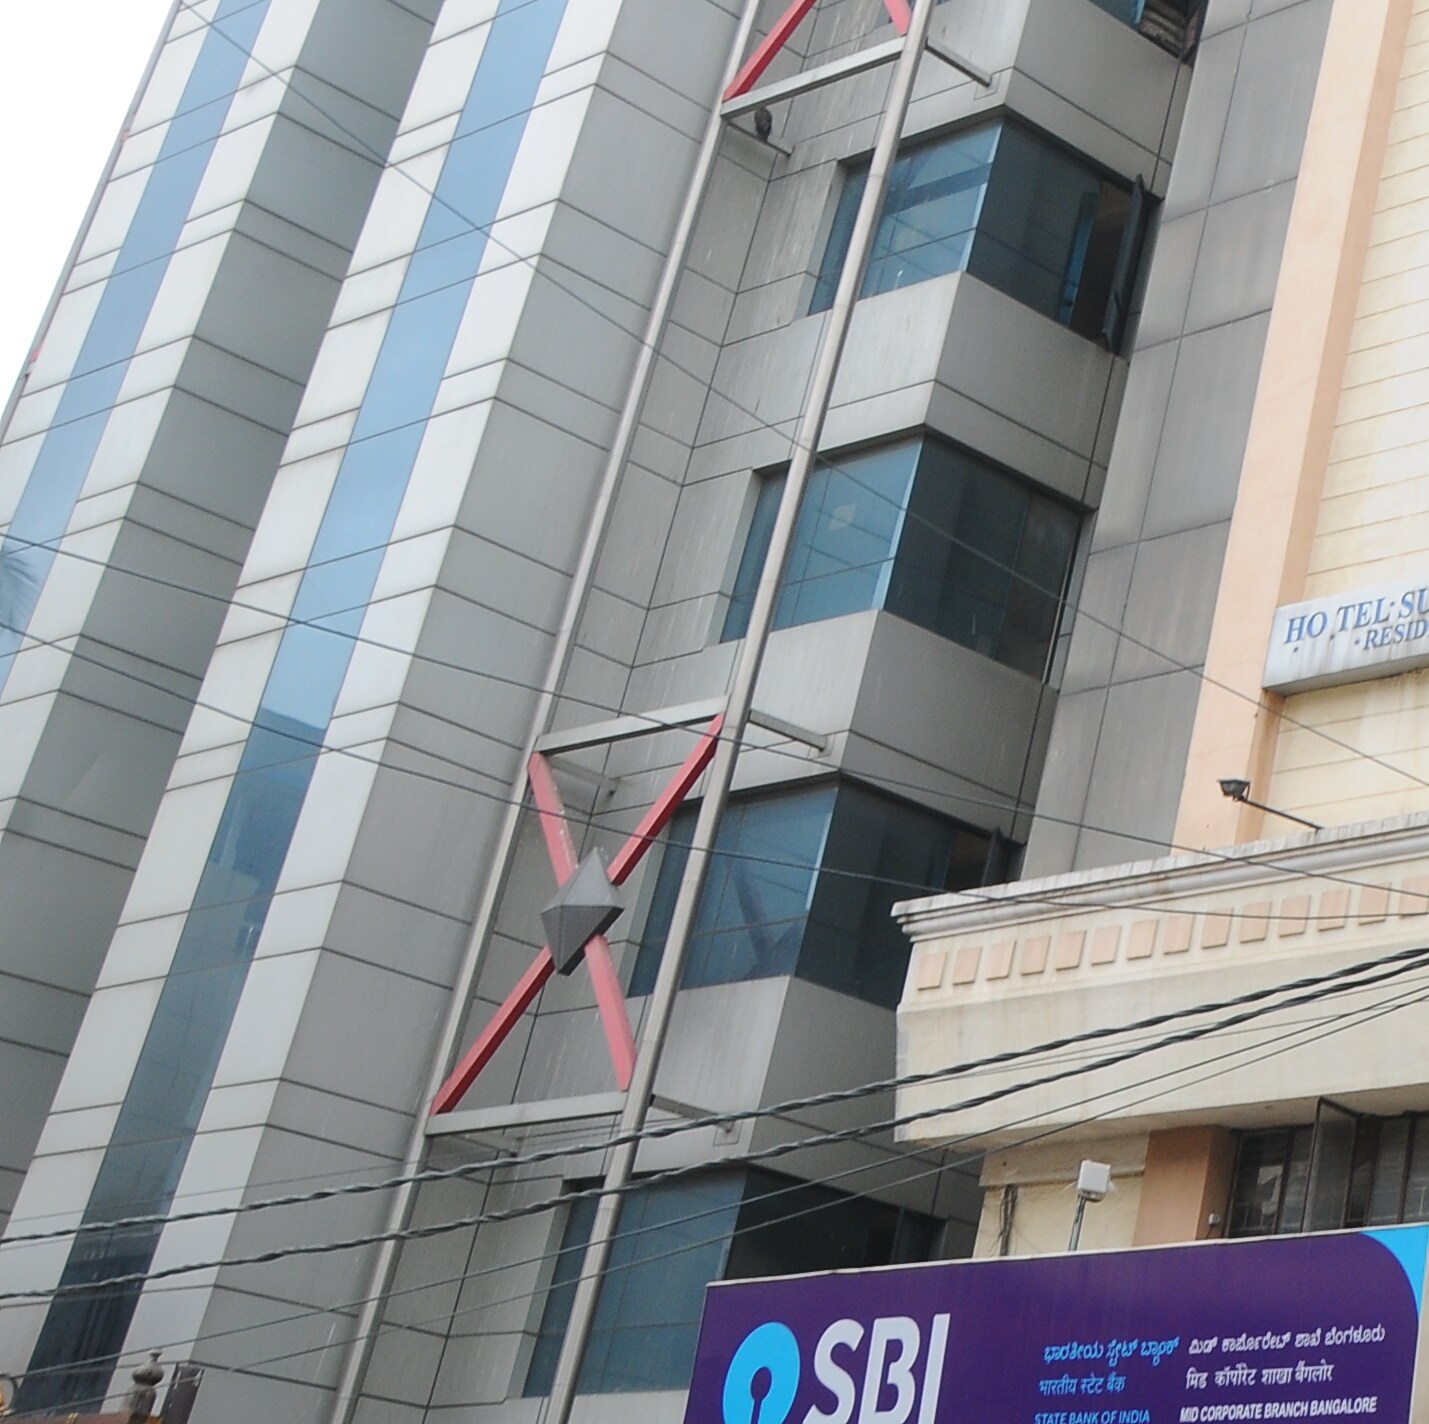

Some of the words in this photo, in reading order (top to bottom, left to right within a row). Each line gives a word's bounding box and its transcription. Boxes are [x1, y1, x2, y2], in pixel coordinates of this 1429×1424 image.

[802, 1313, 951, 1424] SBI
[1261, 1366, 1294, 1386] शाखा
[1039, 1373, 1078, 1395] भारतीय
[1081, 1371, 1105, 1395] स्टेट
[1034, 1412, 1068, 1424] STATE
[1069, 1410, 1099, 1424] BANK
[1100, 1409, 1117, 1424] OF
[1118, 1408, 1151, 1424] INDIA
[1179, 1406, 1199, 1424] MID
[1200, 1402, 1264, 1422] CORPORATE
[1264, 1399, 1309, 1419] BRANCH
[1309, 1395, 1378, 1417] BANGALORE
